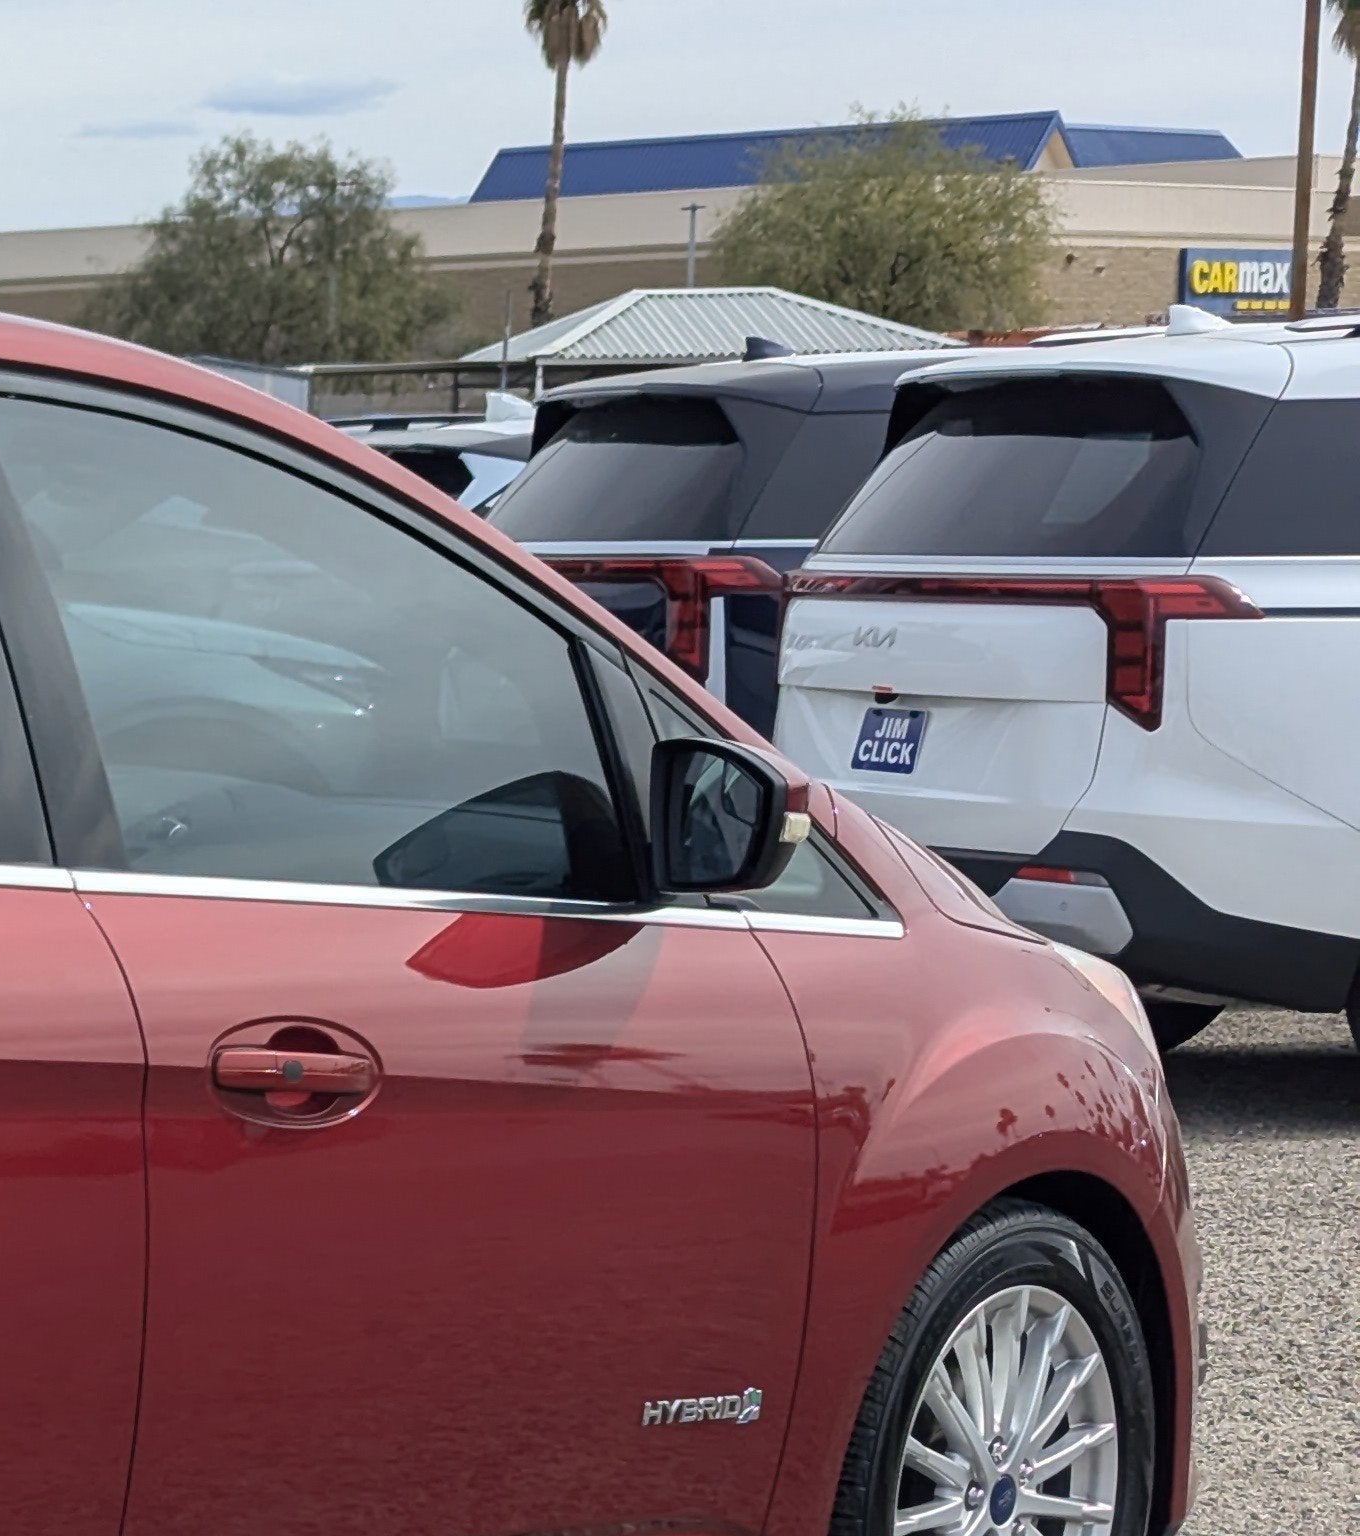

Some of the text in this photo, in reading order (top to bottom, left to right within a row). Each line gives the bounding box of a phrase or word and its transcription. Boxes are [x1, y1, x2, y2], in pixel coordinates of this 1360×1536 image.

[874, 716, 911, 740] JIM
[857, 738, 915, 766] CLICK
[640, 1394, 743, 1427] HYBRID
